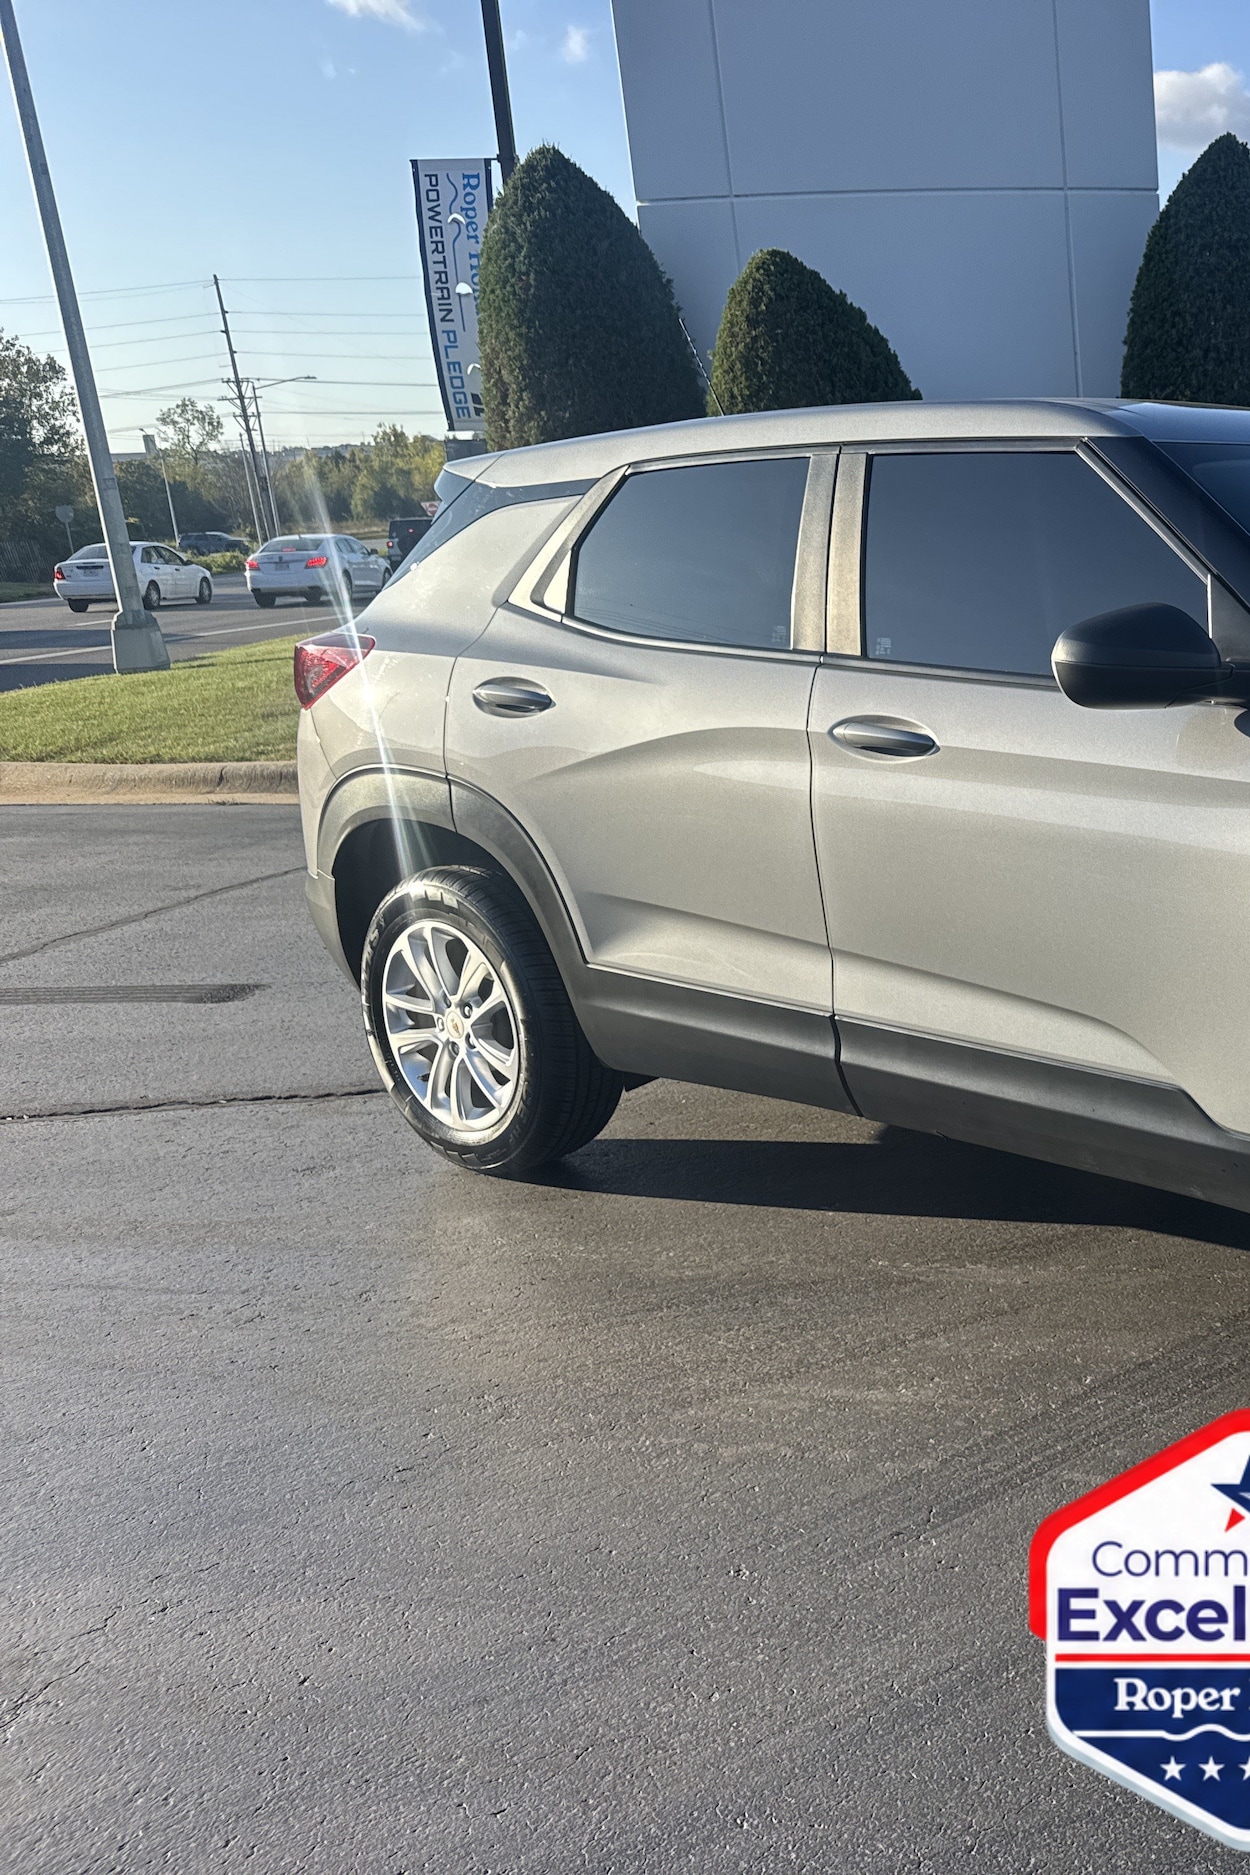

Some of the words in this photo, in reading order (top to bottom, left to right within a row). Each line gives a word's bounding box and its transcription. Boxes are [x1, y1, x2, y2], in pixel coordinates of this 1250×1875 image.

[462, 172, 481, 245] Roper
[424, 173, 455, 323] POWERTRAIN
[442, 329, 471, 419] PLEDGE
